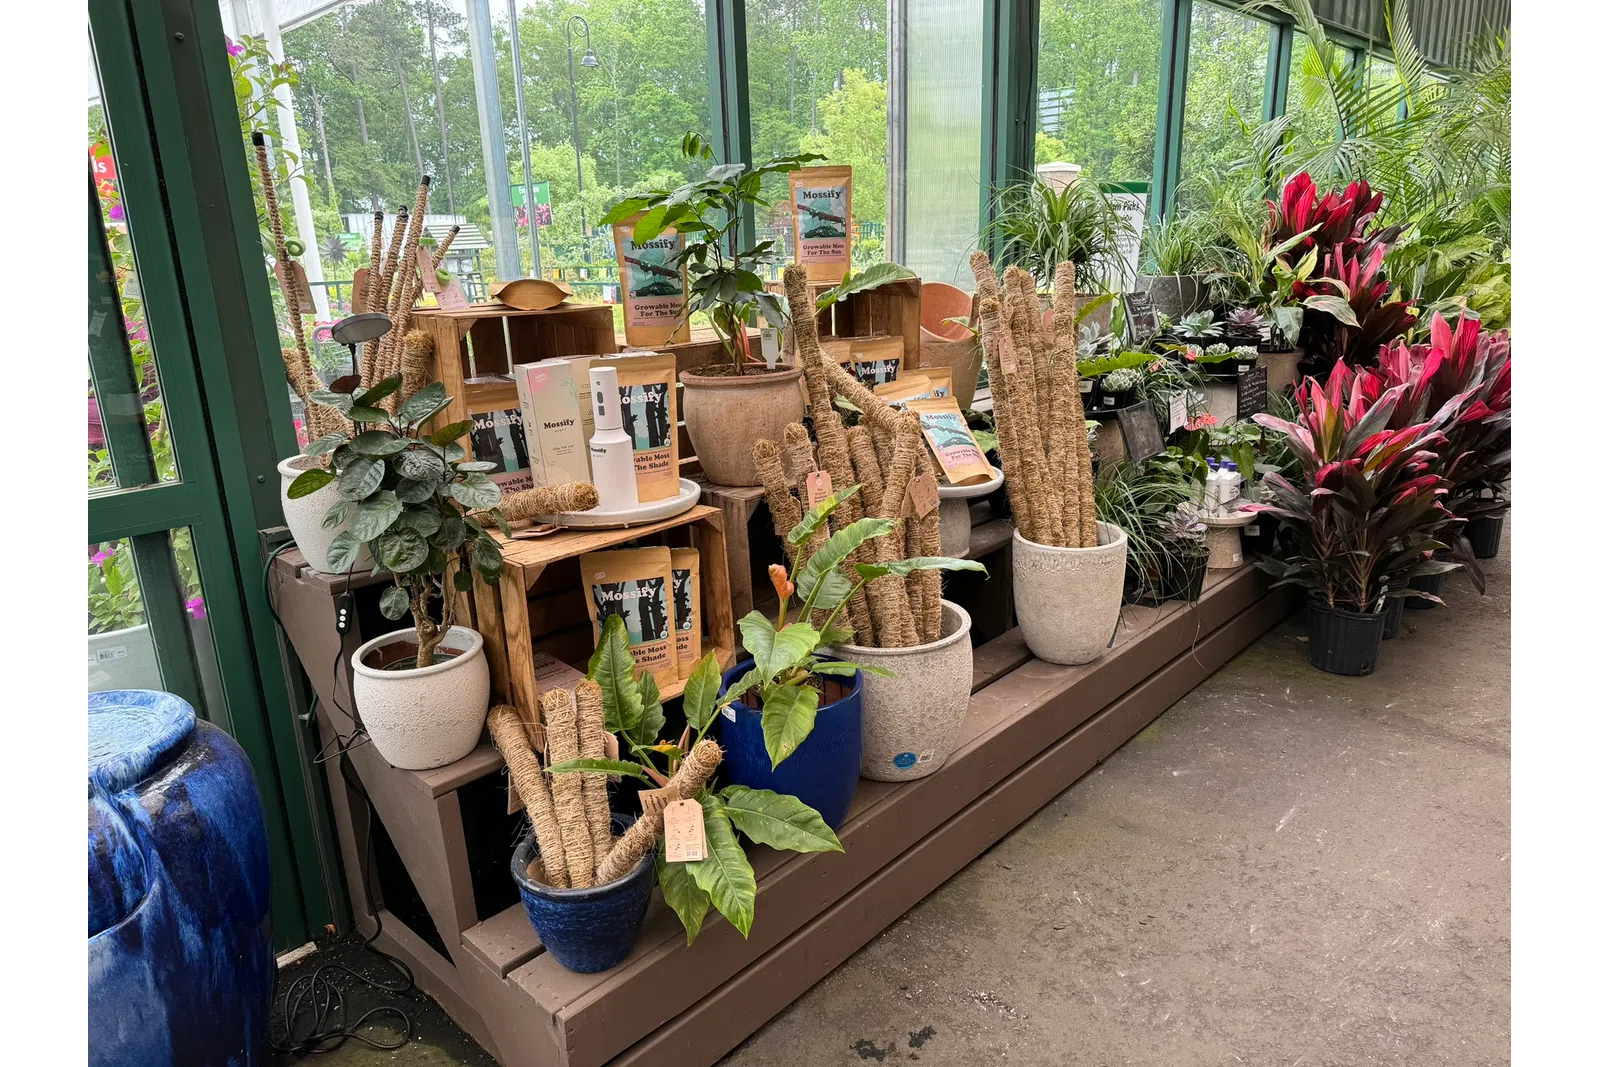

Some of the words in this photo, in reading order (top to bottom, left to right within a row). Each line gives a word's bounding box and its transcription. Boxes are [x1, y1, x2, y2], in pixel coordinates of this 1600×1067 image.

[803, 190, 841, 199] Mossify
[635, 303, 669, 311] Growable
[861, 364, 896, 375] Mossify
[621, 391, 662, 405] ossify
[474, 414, 523, 431] Mossify
[544, 419, 575, 429] Mossify
[654, 453, 670, 461] Moss
[649, 461, 670, 470] Shade
[504, 485, 520, 494] The
[601, 586, 657, 602] Mossify
[647, 644, 667, 653] Moss
[641, 653, 666, 662] Shade
